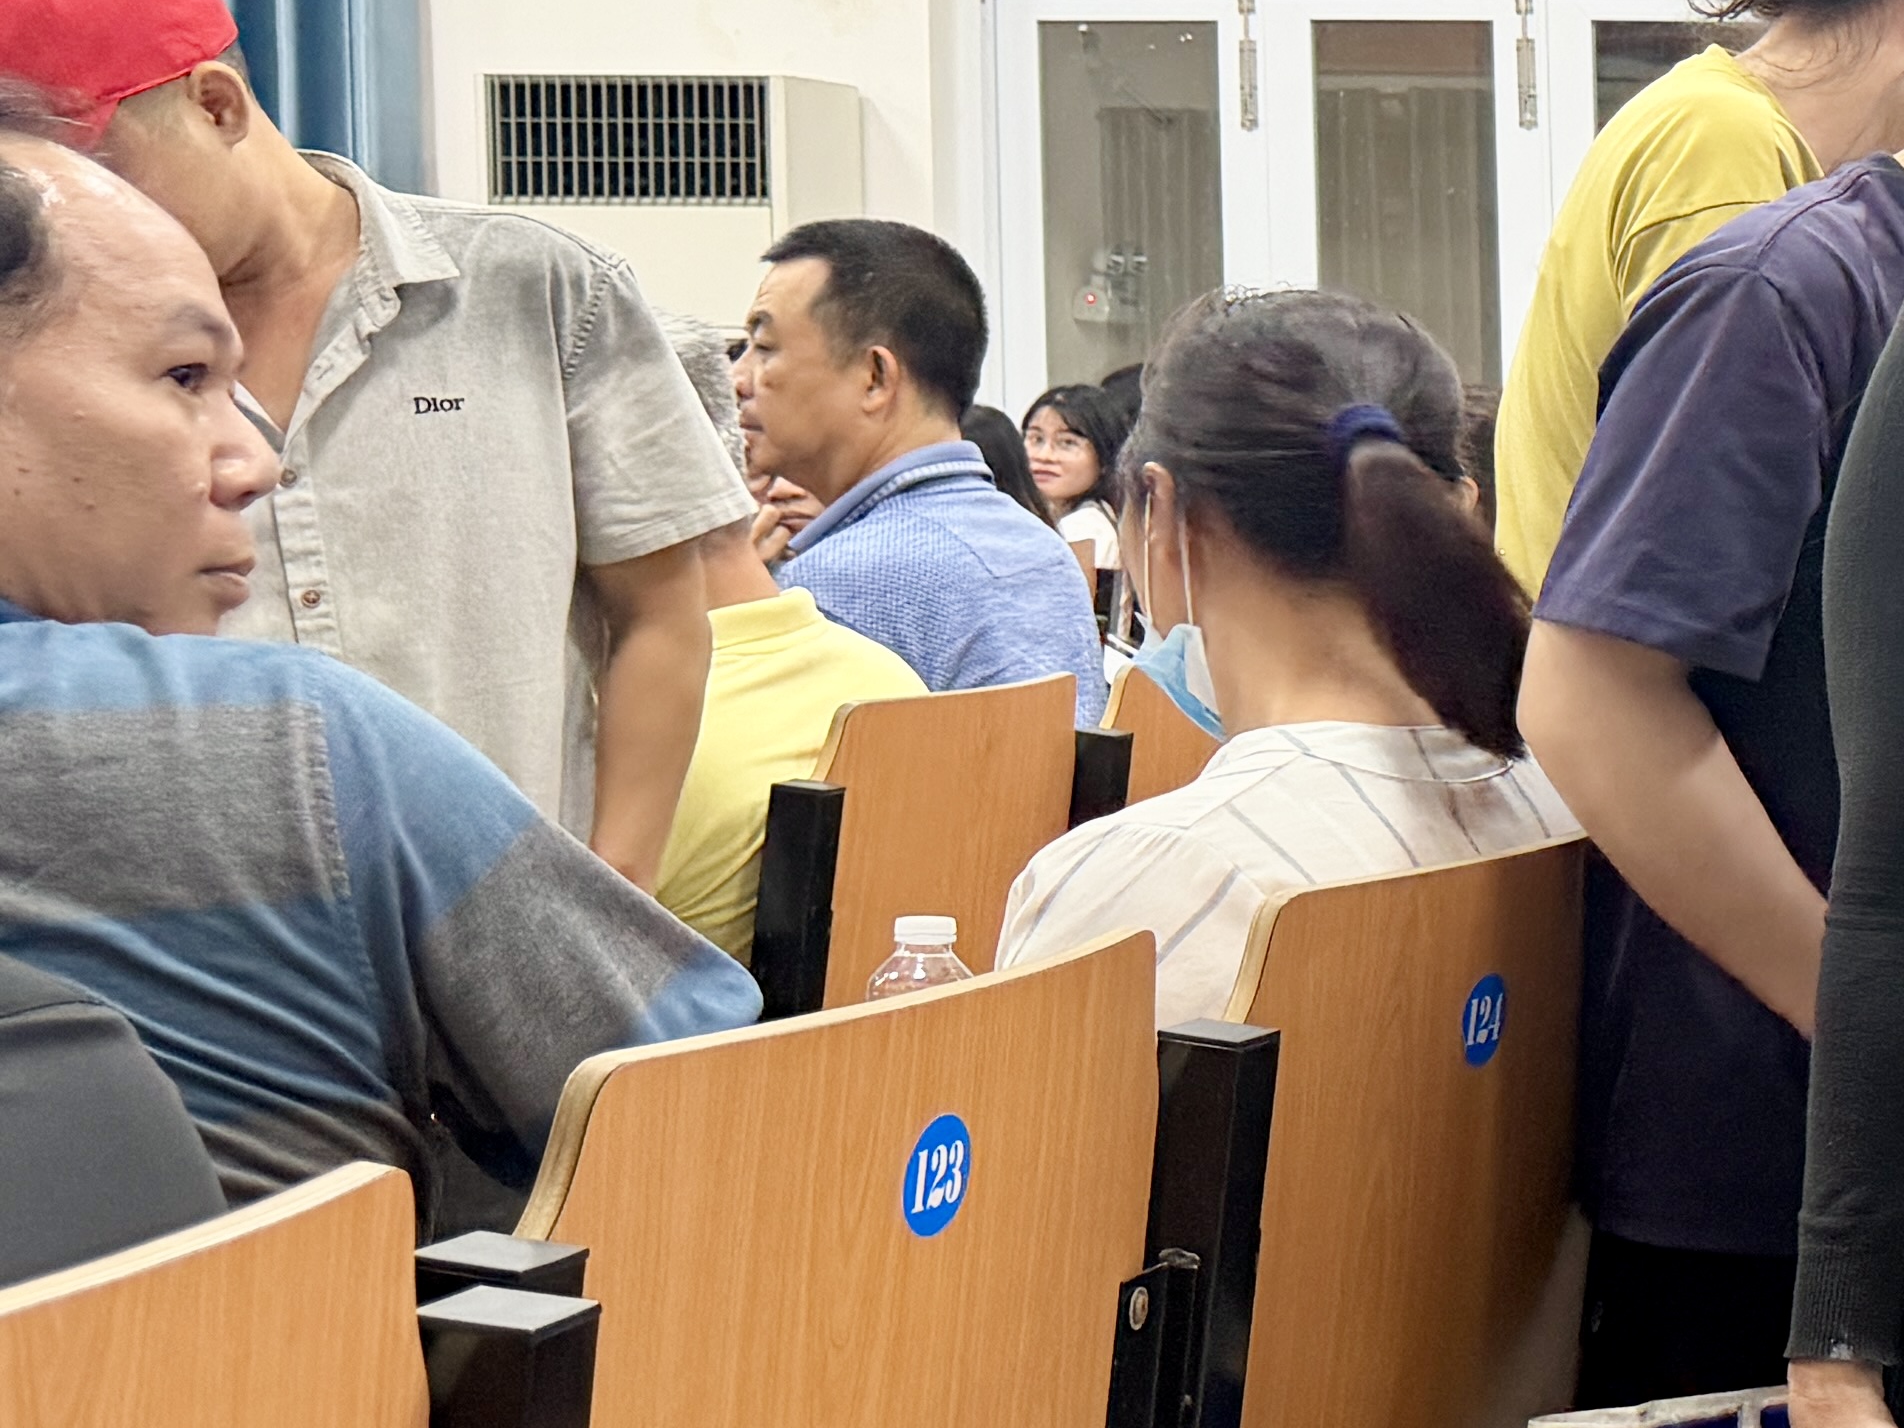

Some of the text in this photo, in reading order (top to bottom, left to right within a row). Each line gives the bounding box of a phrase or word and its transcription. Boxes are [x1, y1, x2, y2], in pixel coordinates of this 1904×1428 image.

[413, 396, 465, 415] Dior
[1466, 992, 1504, 1046] 124
[910, 1138, 966, 1215] 123
